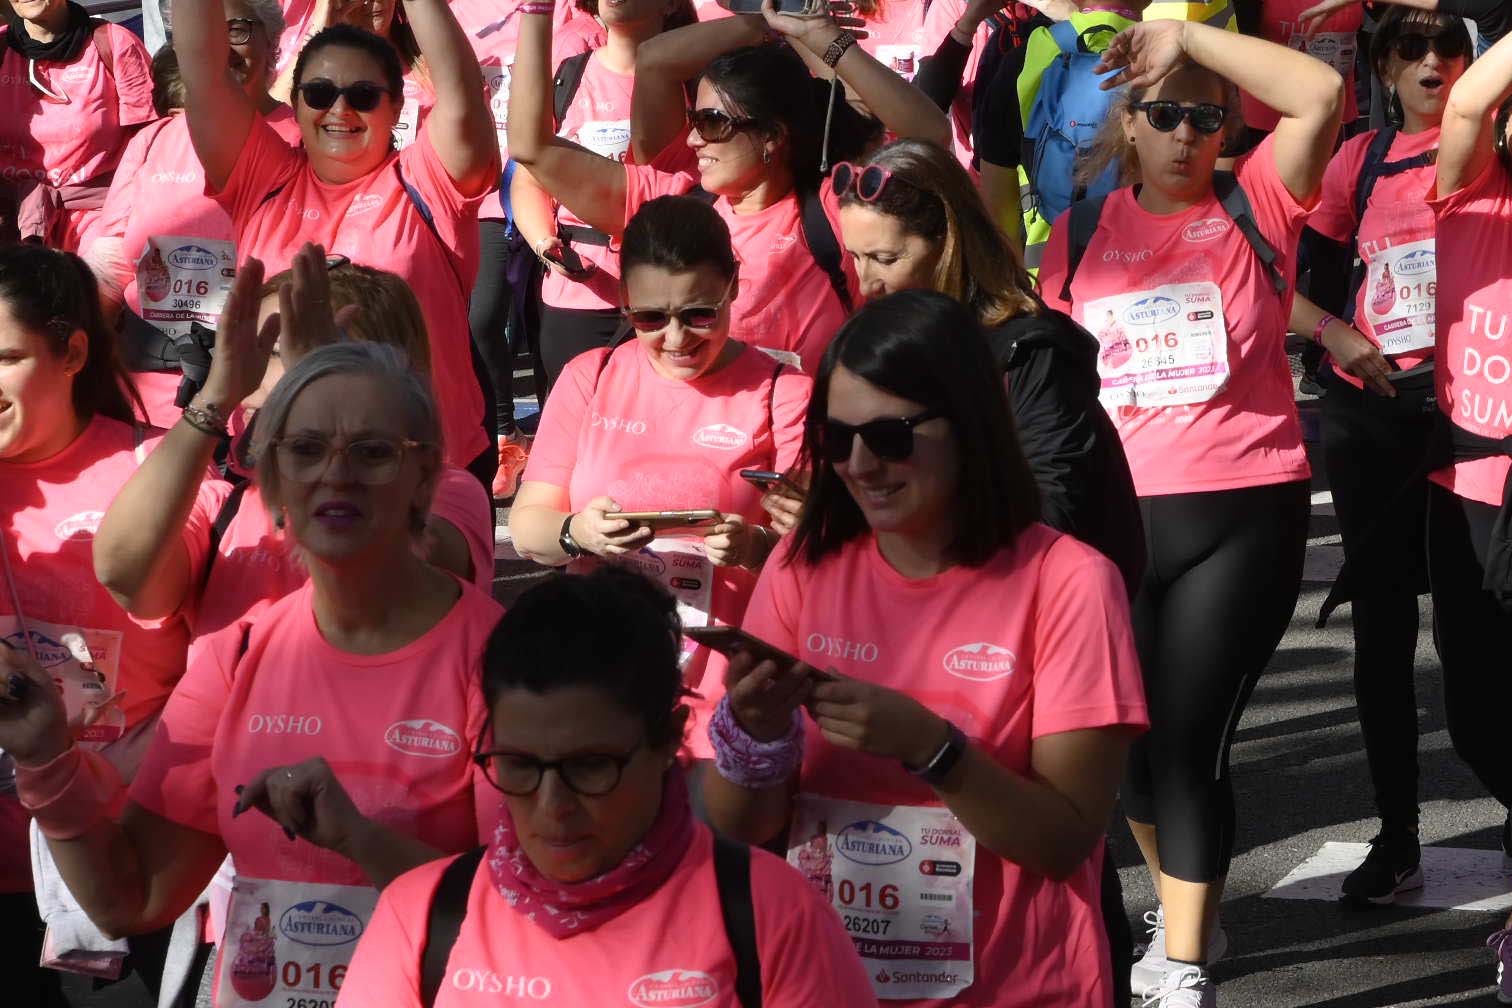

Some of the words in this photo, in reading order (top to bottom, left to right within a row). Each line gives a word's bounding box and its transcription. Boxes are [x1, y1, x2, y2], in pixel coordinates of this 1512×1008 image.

[1398, 260, 1434, 273] ASTURIAN
[173, 279, 209, 296] 016
[172, 299, 201, 310] 30496
[1468, 304, 1508, 341] TU
[1136, 332, 1179, 353] 016
[806, 632, 878, 663] OYSHO
[949, 655, 1012, 673] ASTURIANA
[248, 713, 322, 735] OYSHO
[391, 729, 457, 752] ASTURIANA
[841, 836, 905, 856] ASTURIANA
[920, 835, 961, 847] SUMA
[838, 879, 900, 910] 016
[284, 914, 356, 936] ASTURIANA
[844, 915, 892, 935] 26207
[864, 944, 877, 954] LA
[879, 944, 920, 956] MUJER
[282, 960, 348, 990] 016
[452, 967, 551, 1000] OYSHO
[891, 969, 959, 985] Santander
[635, 984, 713, 1002] ASTURIANA
